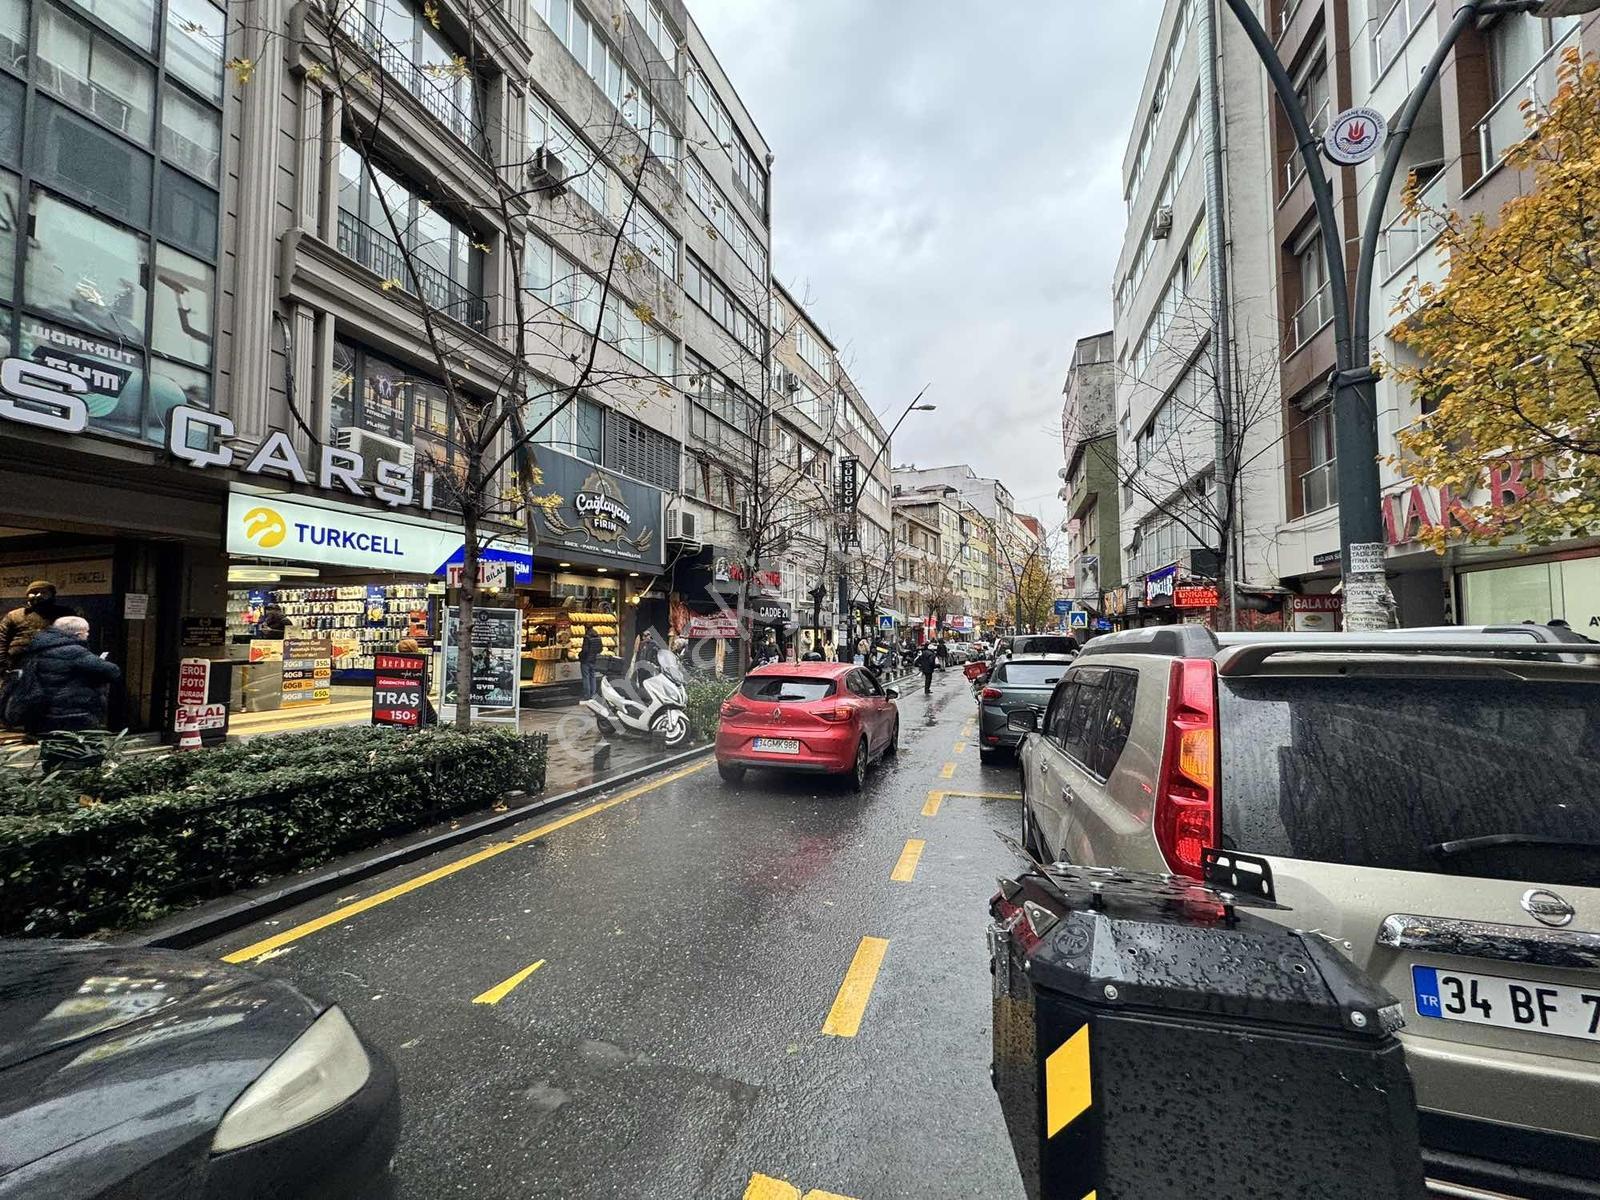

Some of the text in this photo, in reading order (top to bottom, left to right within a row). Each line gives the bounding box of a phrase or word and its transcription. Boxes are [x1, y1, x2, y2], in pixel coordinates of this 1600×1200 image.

[29, 323, 136, 365] WORKOUT
[575, 493, 632, 525] Çağlayan
[294, 522, 405, 556] TURKCELL
[1293, 598, 1322, 610] GALA
[760, 606, 789, 618] CADDE 21
[382, 659, 418, 669] berber
[182, 666, 206, 676] EROL
[283, 670, 303, 678] 40GB
[181, 677, 205, 688] FOTO
[283, 681, 303, 689] 60GB
[180, 690, 205, 699] BURADA
[375, 691, 420, 708] TRAŞ
[1420, 994, 1439, 1008] TR
[1441, 975, 1493, 1019] 34
[1509, 983, 1559, 1028] BF
